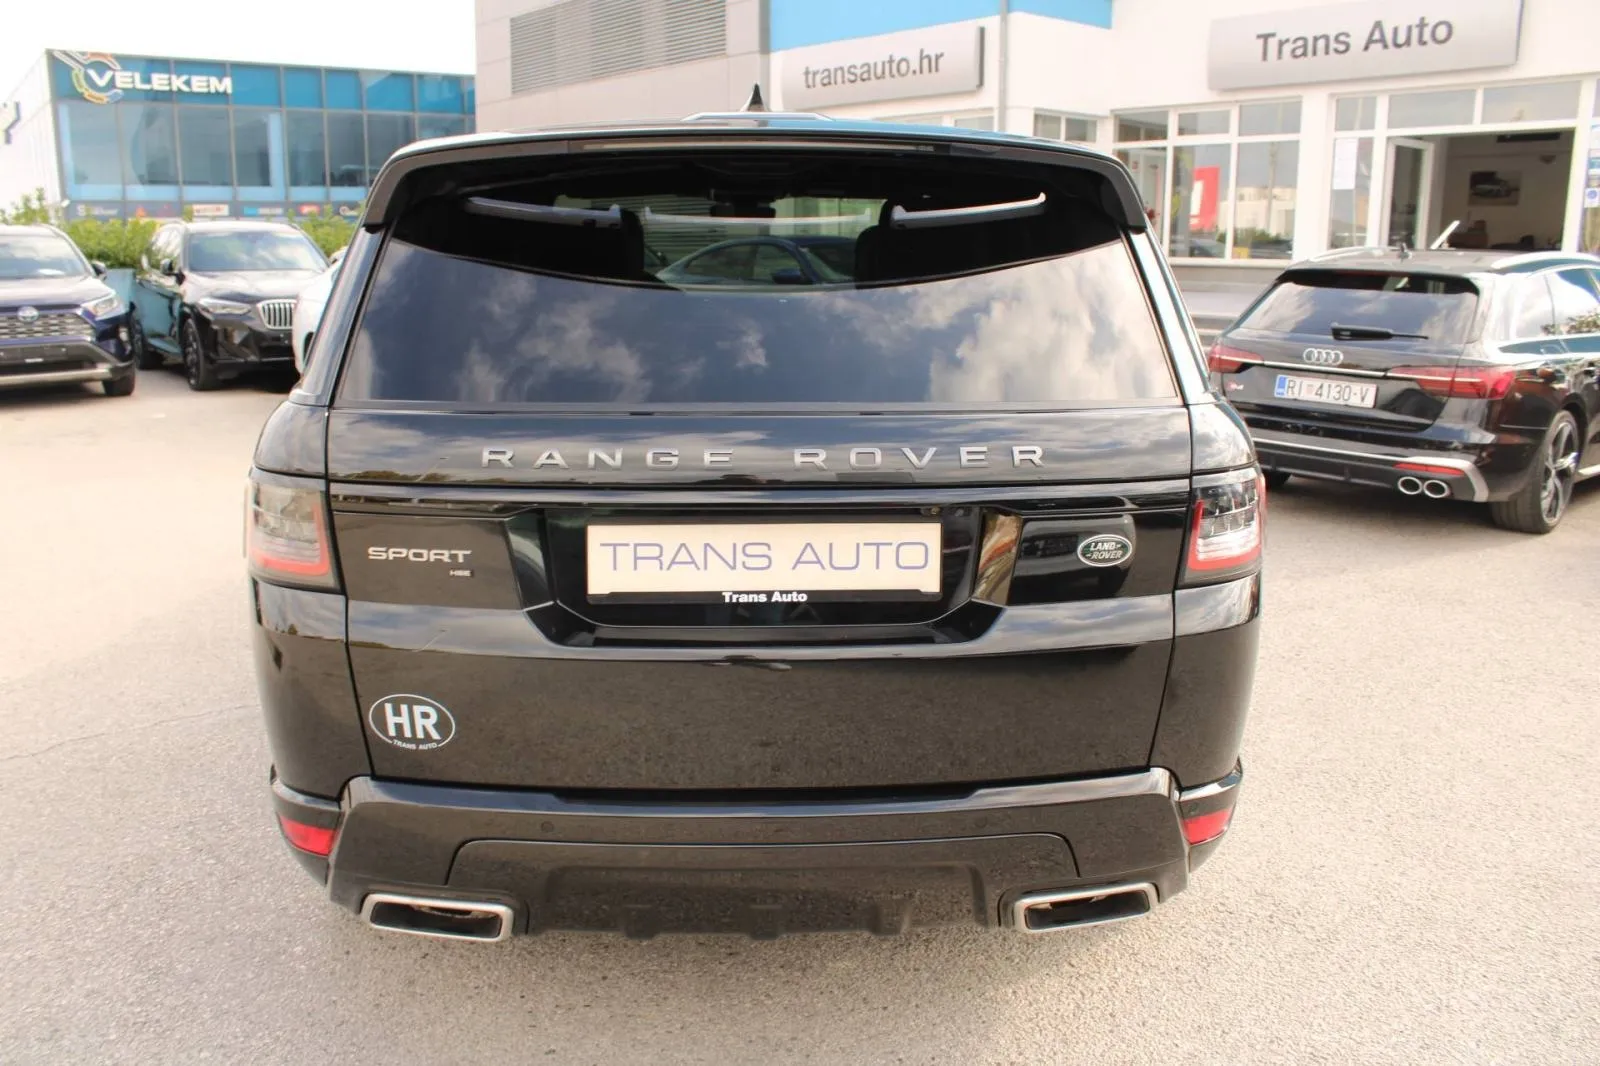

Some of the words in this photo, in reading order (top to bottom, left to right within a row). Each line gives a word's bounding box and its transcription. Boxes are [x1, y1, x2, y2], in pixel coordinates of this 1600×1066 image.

[1256, 32, 1352, 62] Trans
[1362, 16, 1454, 51] Auto
[86, 68, 233, 94] VELEKEM
[803, 48, 945, 89] transauto.hr
[1287, 379, 1304, 397] RI
[481, 447, 734, 471] RANGE
[793, 445, 1045, 471] ROVER
[367, 546, 473, 563] SPORT
[599, 542, 773, 571] TRANS
[791, 541, 930, 571] AUTO
[722, 591, 767, 603] Trans
[771, 590, 808, 603] Auto
[384, 702, 442, 740] HR
[392, 739, 417, 750] TRANS
[418, 742, 438, 750] AUTO
